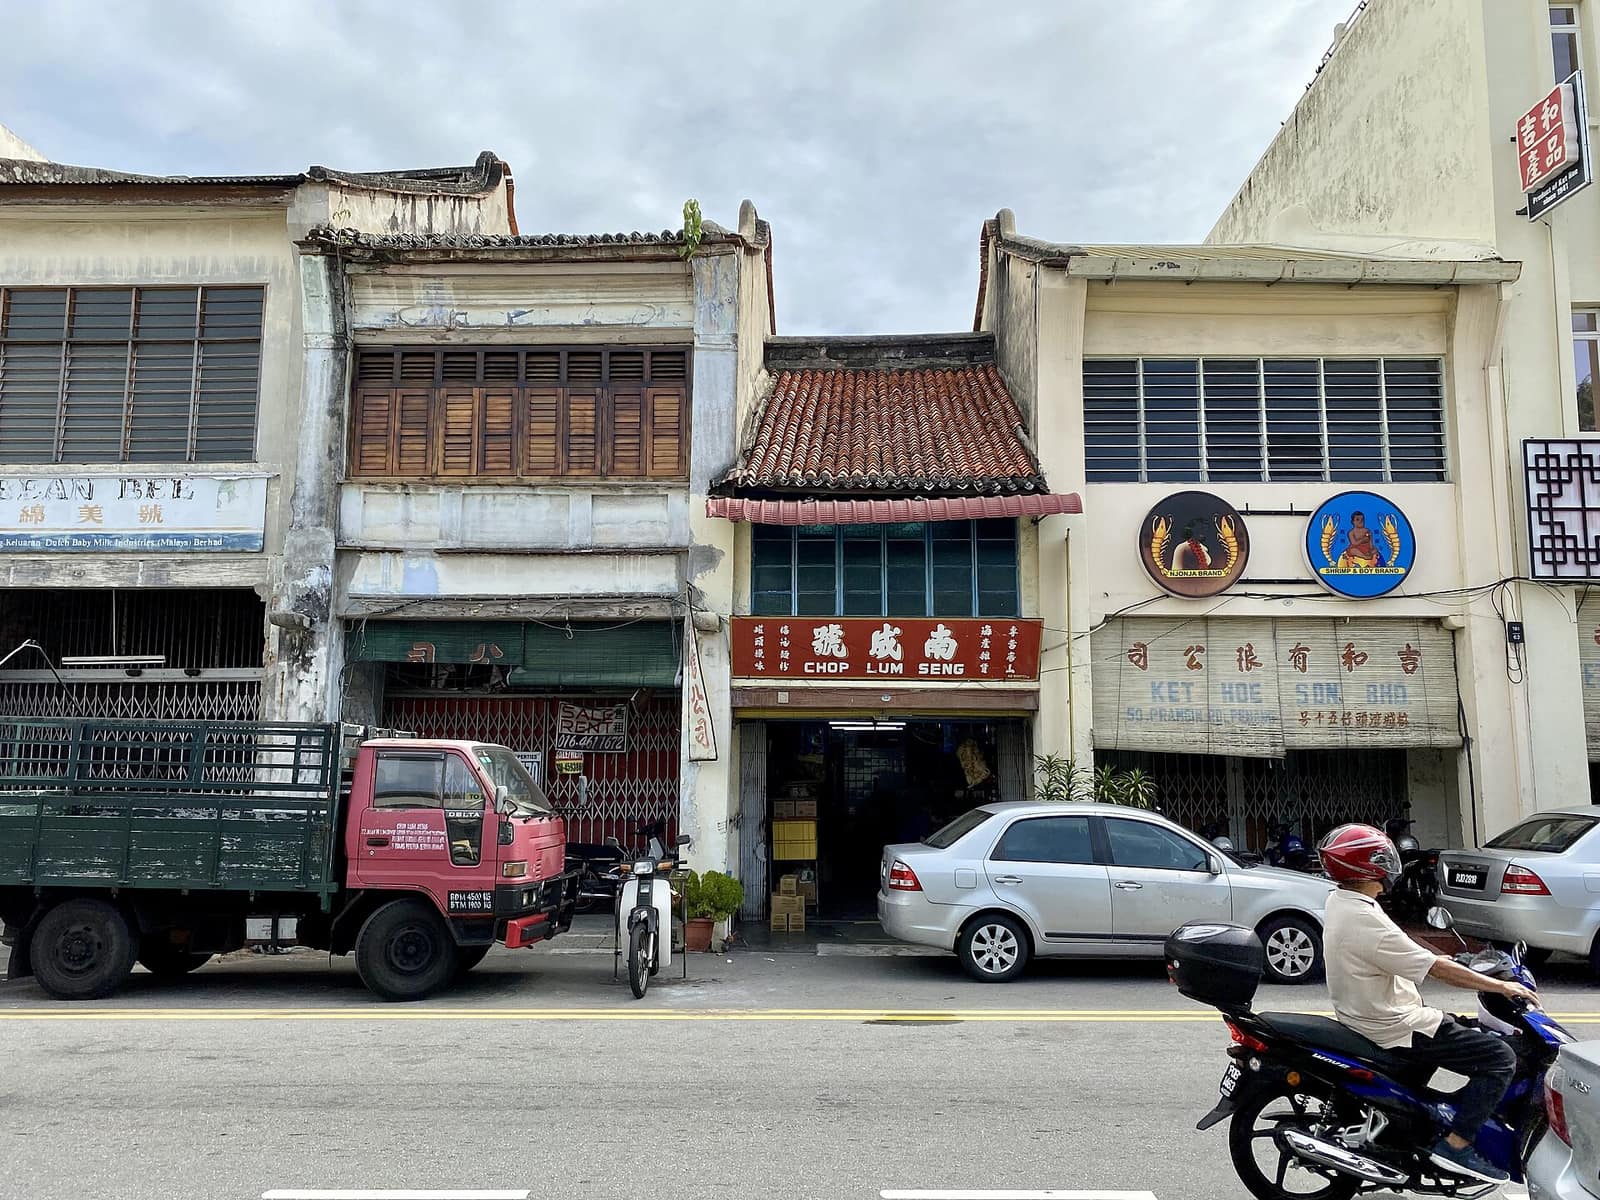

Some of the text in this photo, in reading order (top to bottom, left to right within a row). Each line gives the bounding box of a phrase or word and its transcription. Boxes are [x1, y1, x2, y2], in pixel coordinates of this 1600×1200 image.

[1520, 99, 1559, 147] 吉和
[45, 538, 69, 547] Dutch
[72, 538, 91, 550] Baby
[194, 538, 223, 547] Berhad
[804, 662, 964, 675] CHOP LUM SENG
[1151, 681, 1195, 703] KET
[1221, 682, 1263, 704] HOE
[1366, 682, 1409, 704] BHD
[562, 704, 615, 720] SALE
[561, 720, 613, 733] RENT
